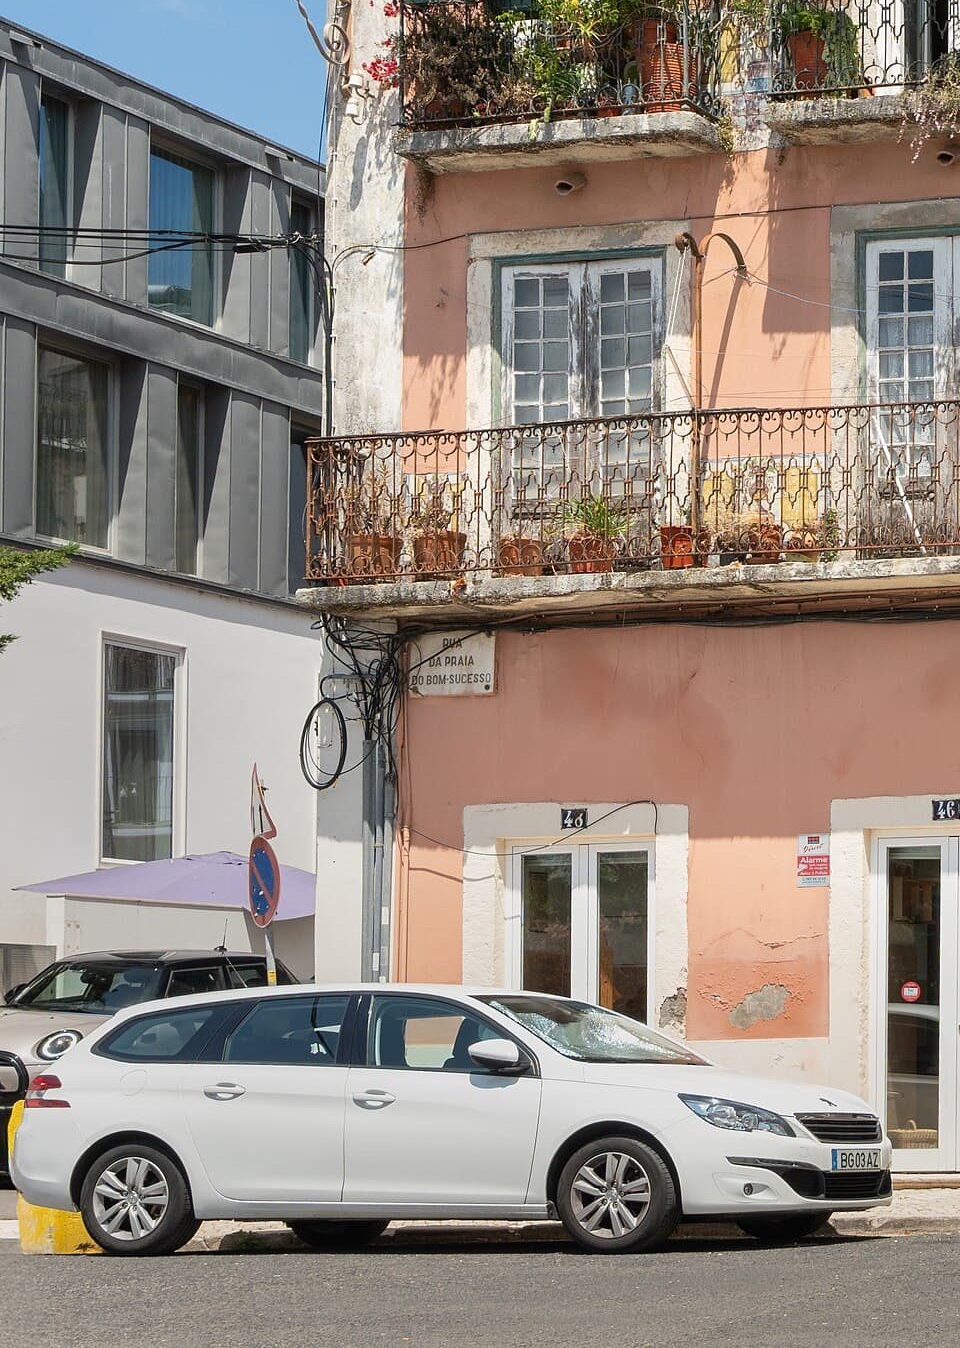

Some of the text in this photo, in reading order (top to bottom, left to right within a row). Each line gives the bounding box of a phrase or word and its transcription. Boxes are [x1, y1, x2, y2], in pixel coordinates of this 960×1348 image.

[442, 638, 463, 648] RUA
[429, 655, 475, 668] DA PRAIA
[937, 801, 955, 819] 46
[563, 810, 584, 828] 46
[800, 856, 828, 864] Alarme
